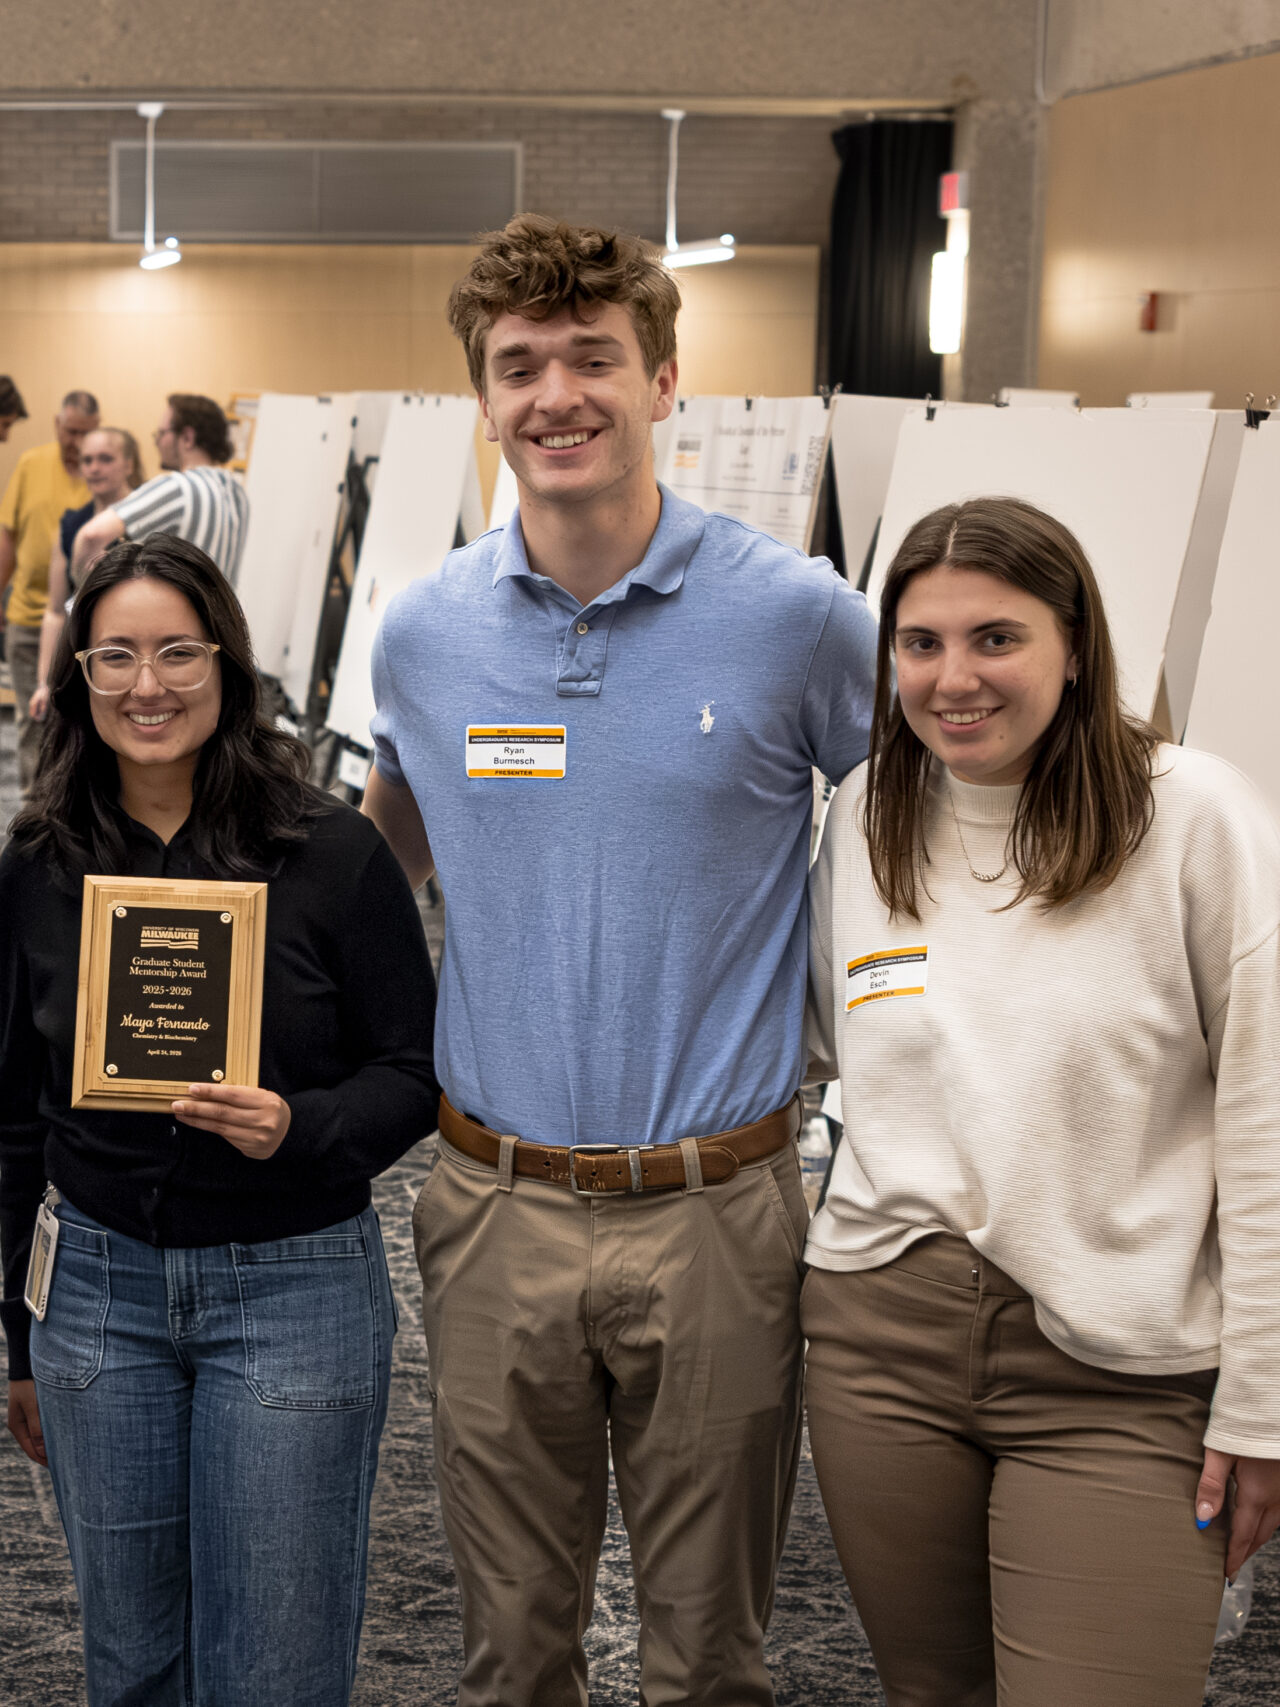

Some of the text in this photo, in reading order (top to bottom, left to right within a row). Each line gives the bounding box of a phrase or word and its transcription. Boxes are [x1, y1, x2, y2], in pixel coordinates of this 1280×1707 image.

[504, 747, 524, 755] Ryan
[141, 930, 199, 940] MILWAUKEE
[132, 956, 205, 968] Graduate Student
[129, 966, 207, 978] Mentorship Award
[870, 969, 889, 979] Devin
[870, 980, 887, 989] Esch
[142, 985, 192, 995] 2025-2026
[863, 992, 894, 1001] PRESENTER
[120, 1014, 210, 1032] Maya Fernando
[165, 1034, 198, 1042] Biochemistry
